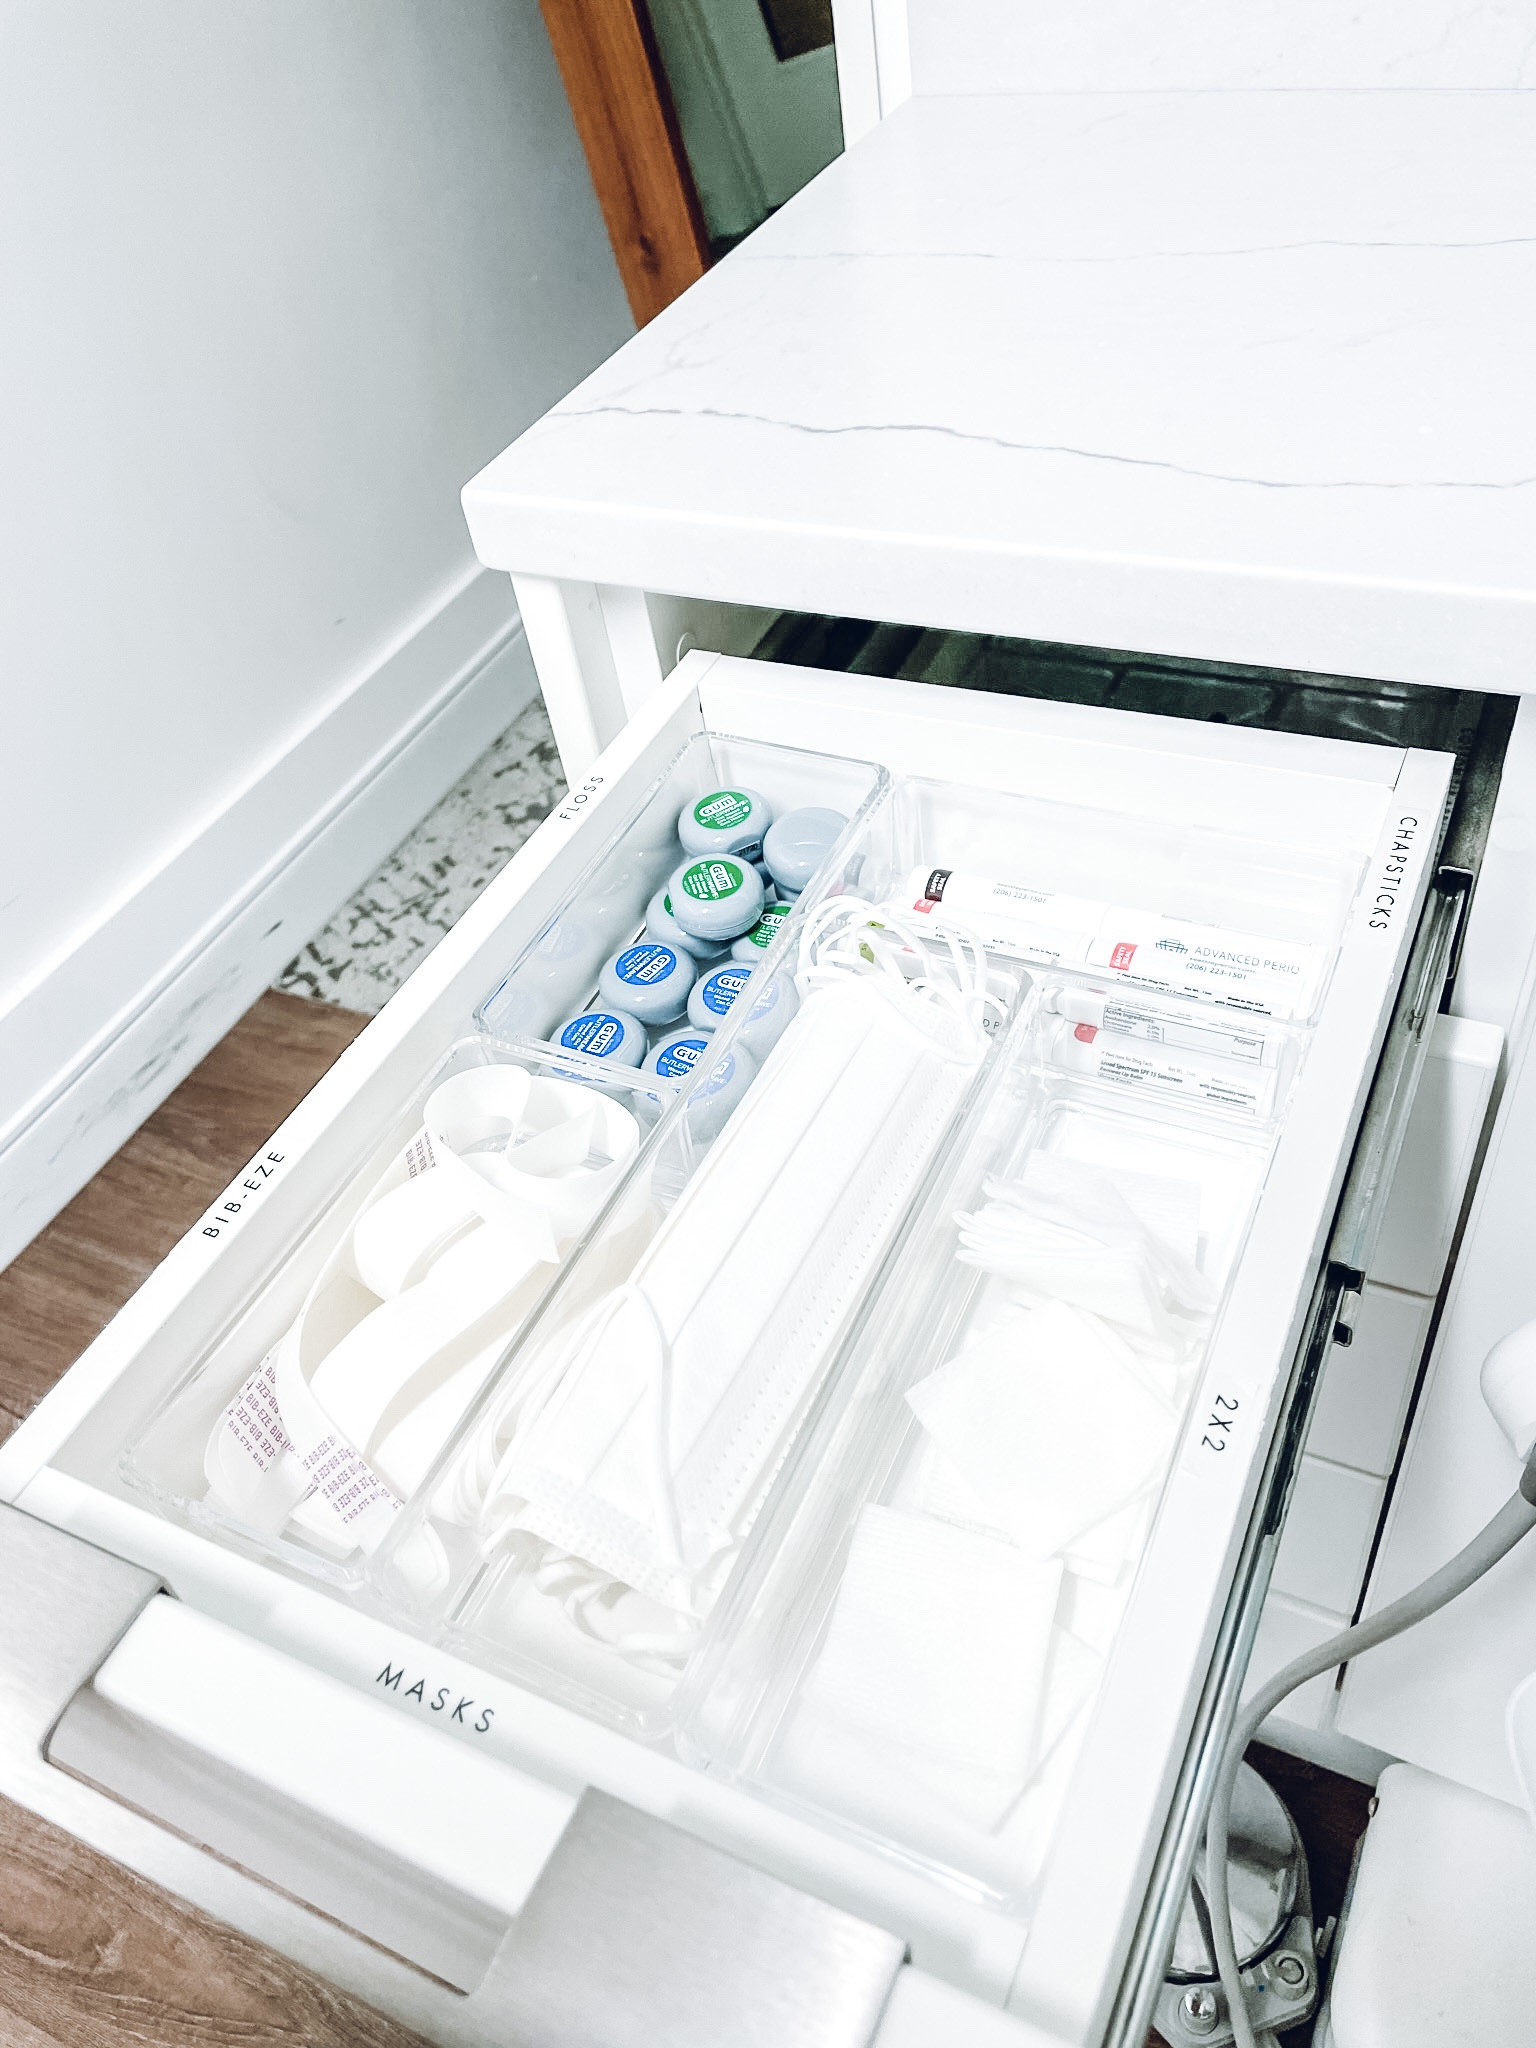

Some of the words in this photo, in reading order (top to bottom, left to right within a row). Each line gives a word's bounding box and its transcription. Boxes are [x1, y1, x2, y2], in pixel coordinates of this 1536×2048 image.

[559, 776, 604, 820] FLOSS
[1369, 816, 1418, 929] CHAPSTICKS
[993, 888, 1012, 898] (206)
[762, 915, 783, 924] GU
[1185, 962, 1207, 973] (206)
[1209, 967, 1247, 980] 223-1501
[1194, 946, 1260, 966] ADVANCED
[1263, 959, 1300, 975] PERIO
[720, 977, 746, 989] GU
[676, 1048, 698, 1061] GU
[202, 1151, 285, 1238] BIB-EZE
[235, 1406, 263, 1441] BIB-EZE
[245, 1393, 273, 1428] BIB-EZE
[1202, 1394, 1239, 1452] 2X2
[376, 1662, 495, 1733] MASKS
